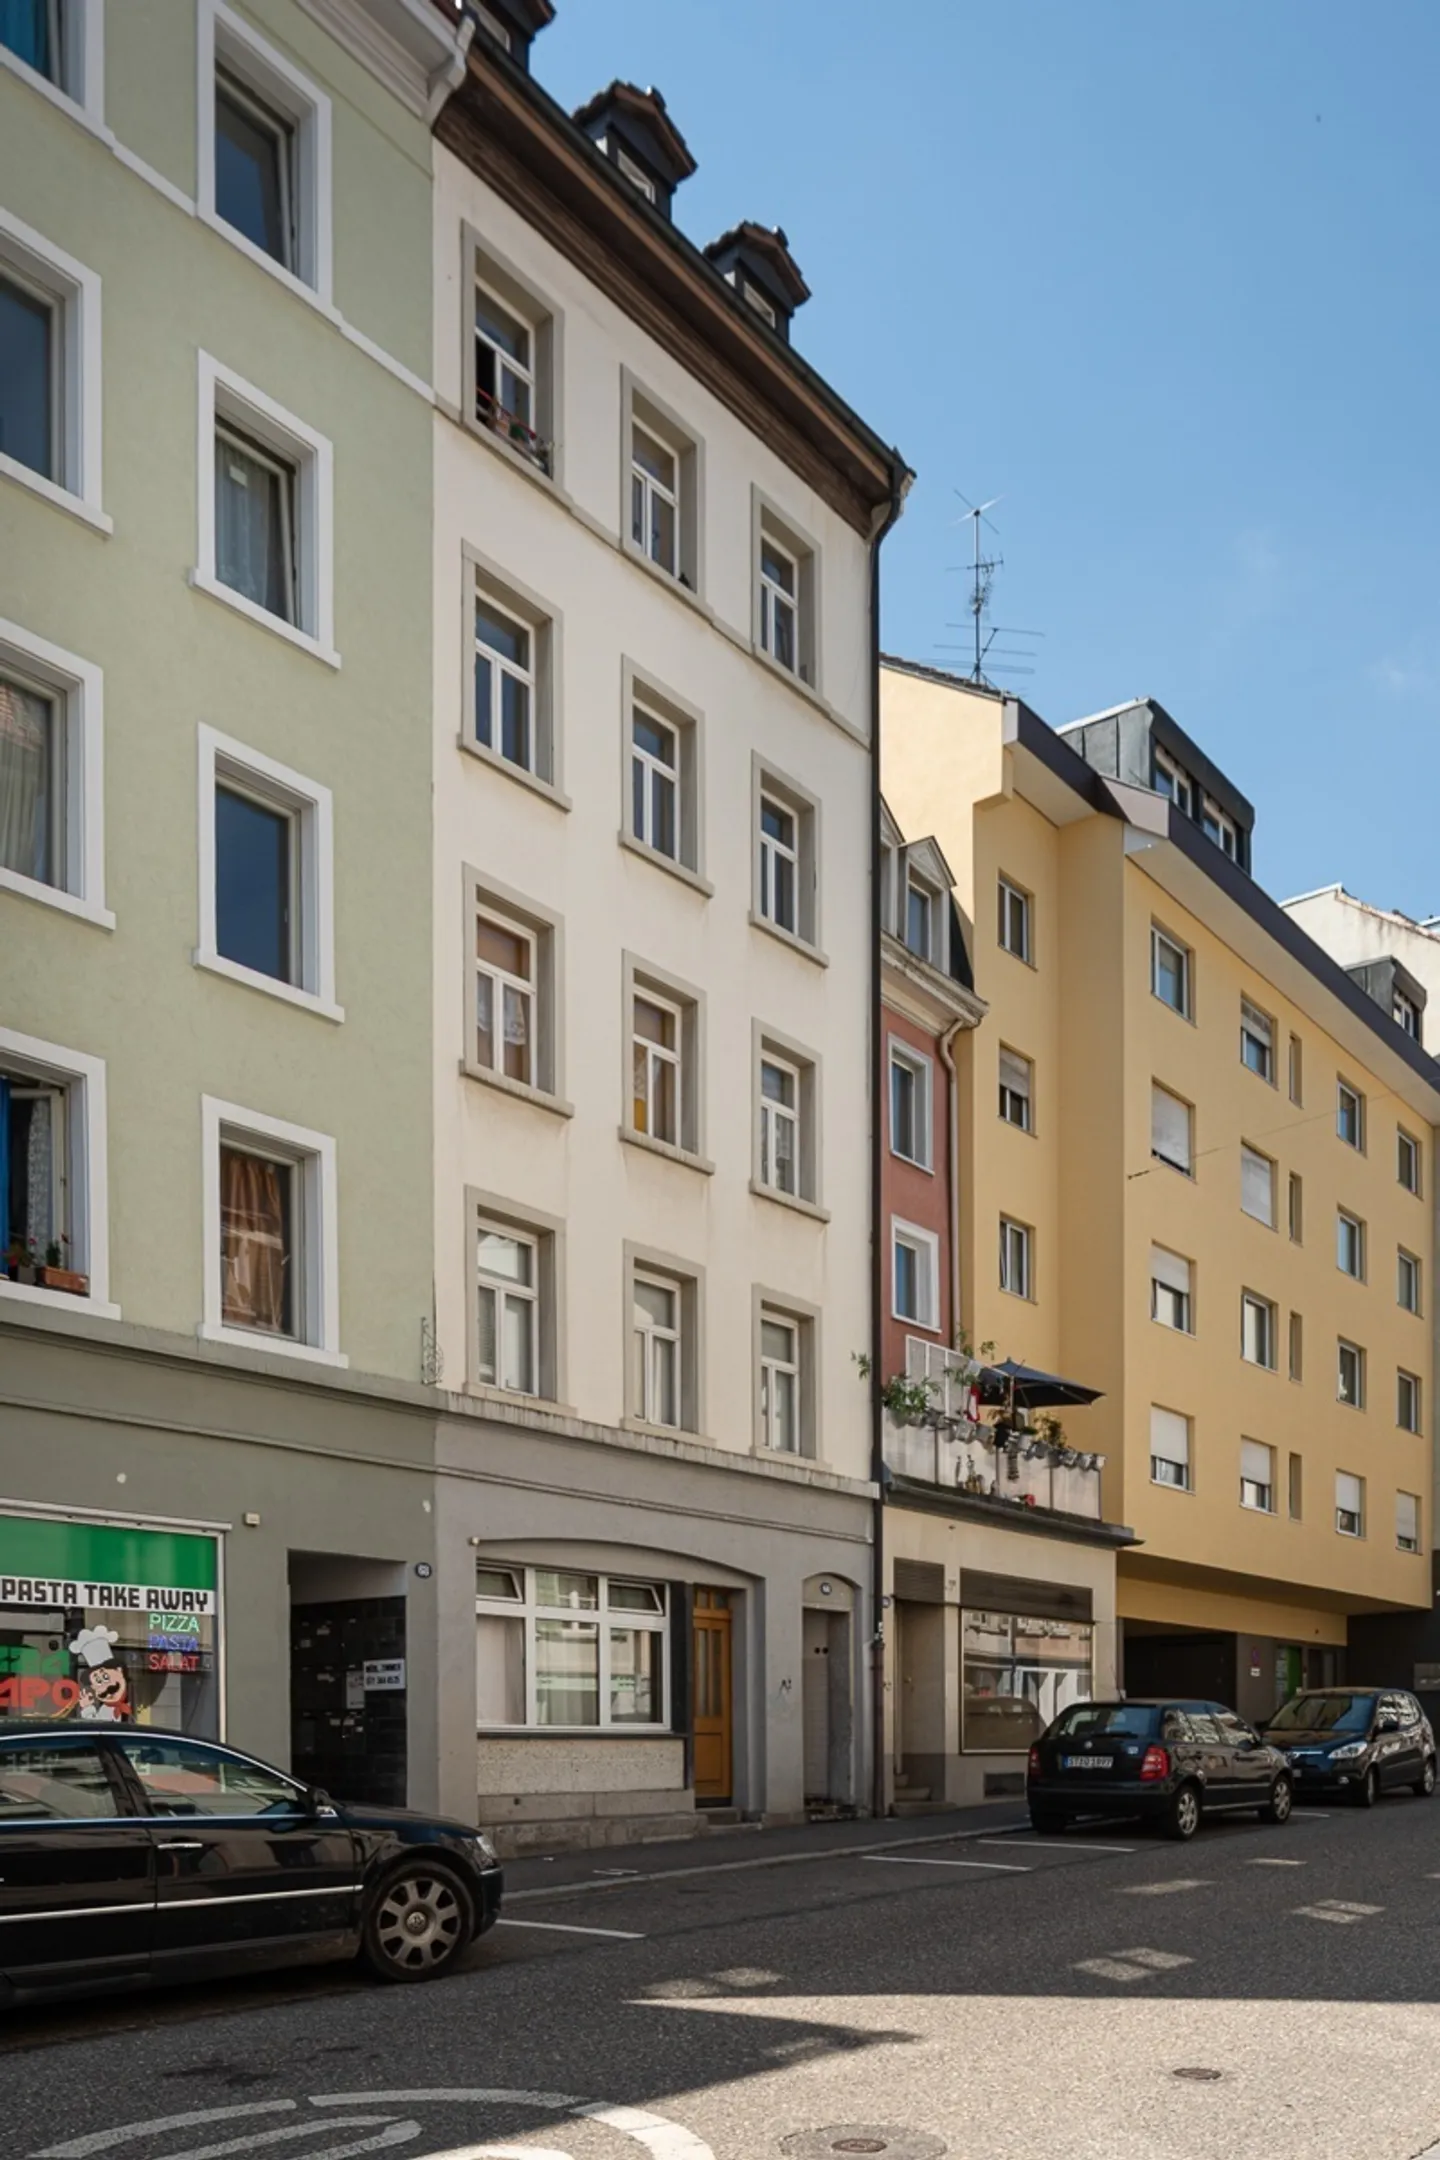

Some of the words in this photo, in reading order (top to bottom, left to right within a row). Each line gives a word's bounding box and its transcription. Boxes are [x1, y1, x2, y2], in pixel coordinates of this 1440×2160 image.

[2, 1578, 77, 1604] PASTA
[84, 1584, 140, 1608] TAKE
[146, 1589, 208, 1612] AWAY
[149, 1614, 200, 1633] PIZZA
[149, 1634, 199, 1652] PASTA
[148, 1653, 200, 1671] SALAT
